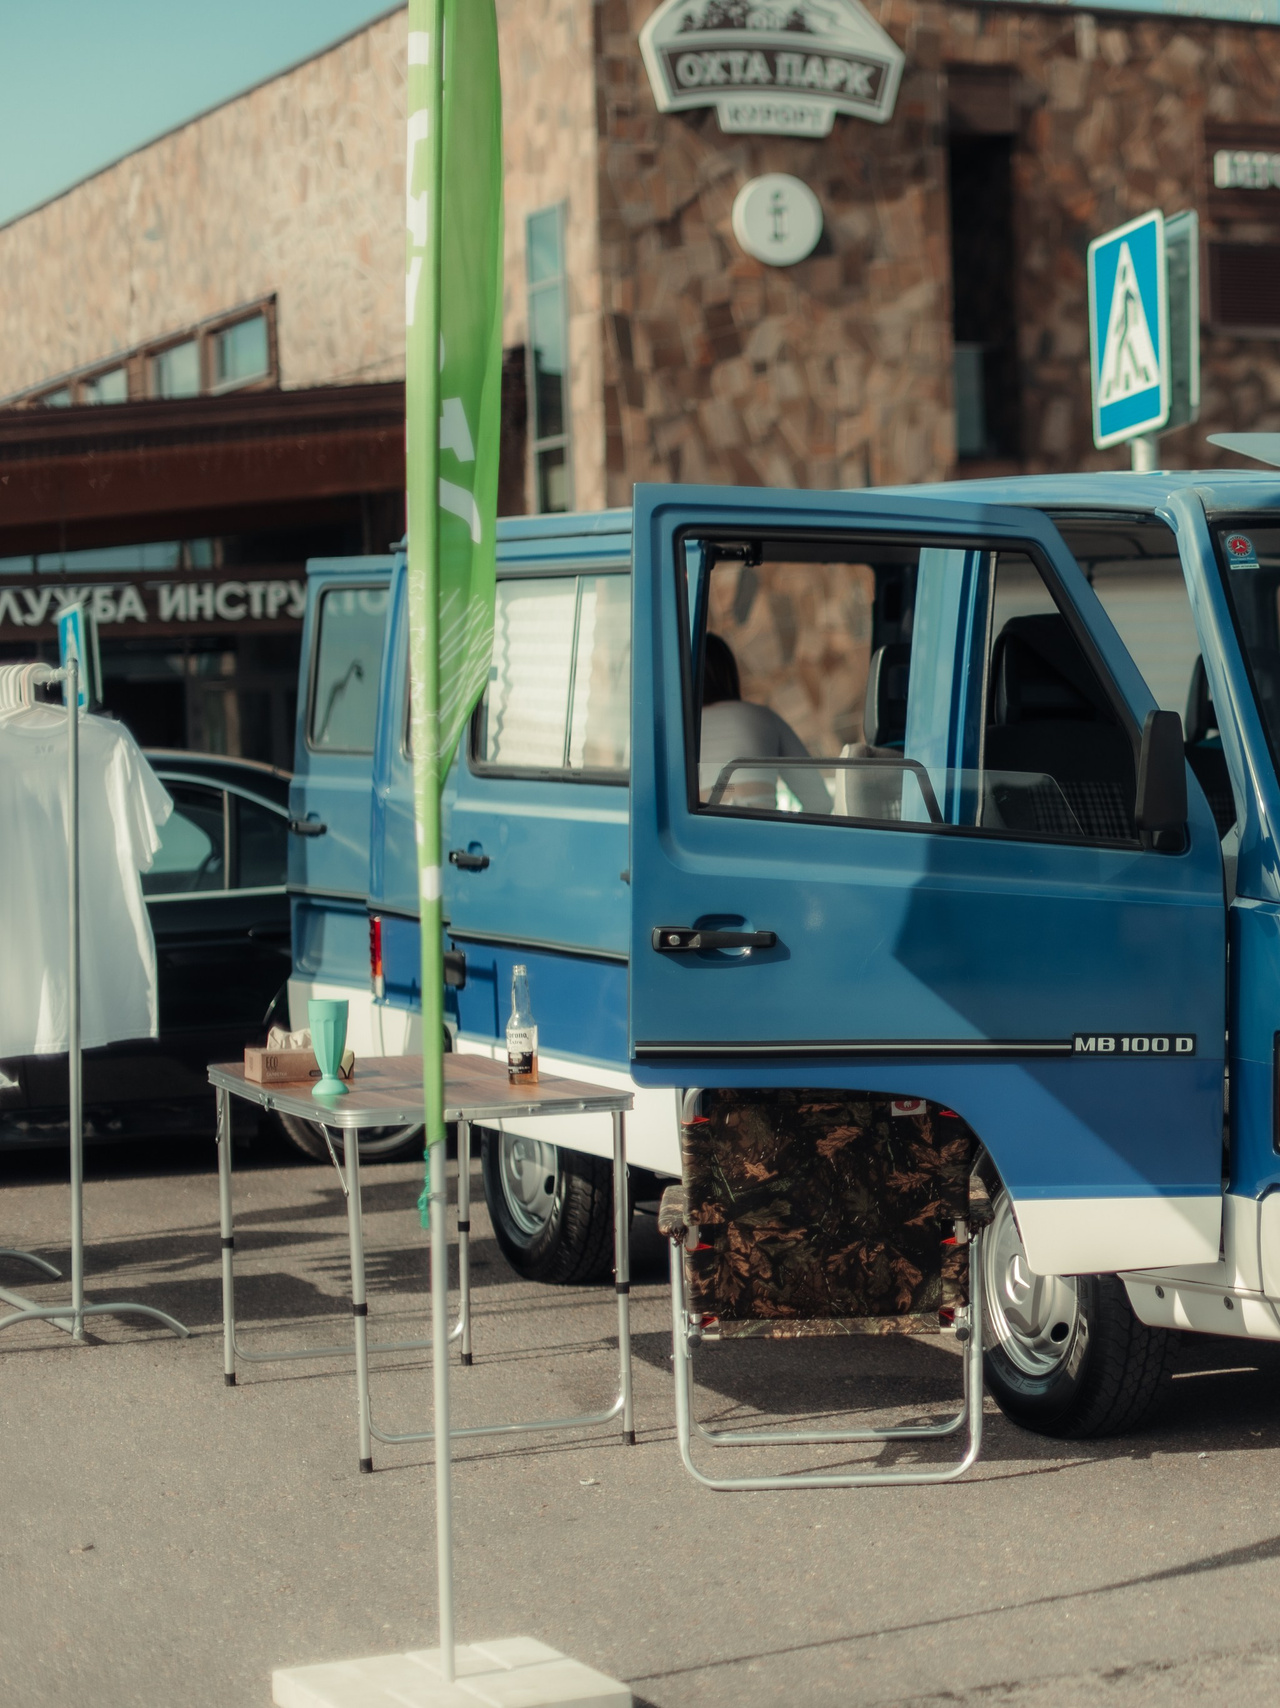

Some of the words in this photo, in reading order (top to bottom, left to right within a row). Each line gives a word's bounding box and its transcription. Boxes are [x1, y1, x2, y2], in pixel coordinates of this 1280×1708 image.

[676, 50, 773, 88] ОХТА
[775, 52, 876, 97] ПАРК
[1074, 1037, 1116, 1052] MB
[1121, 1037, 1170, 1052] 100
[1175, 1037, 1194, 1052] D
